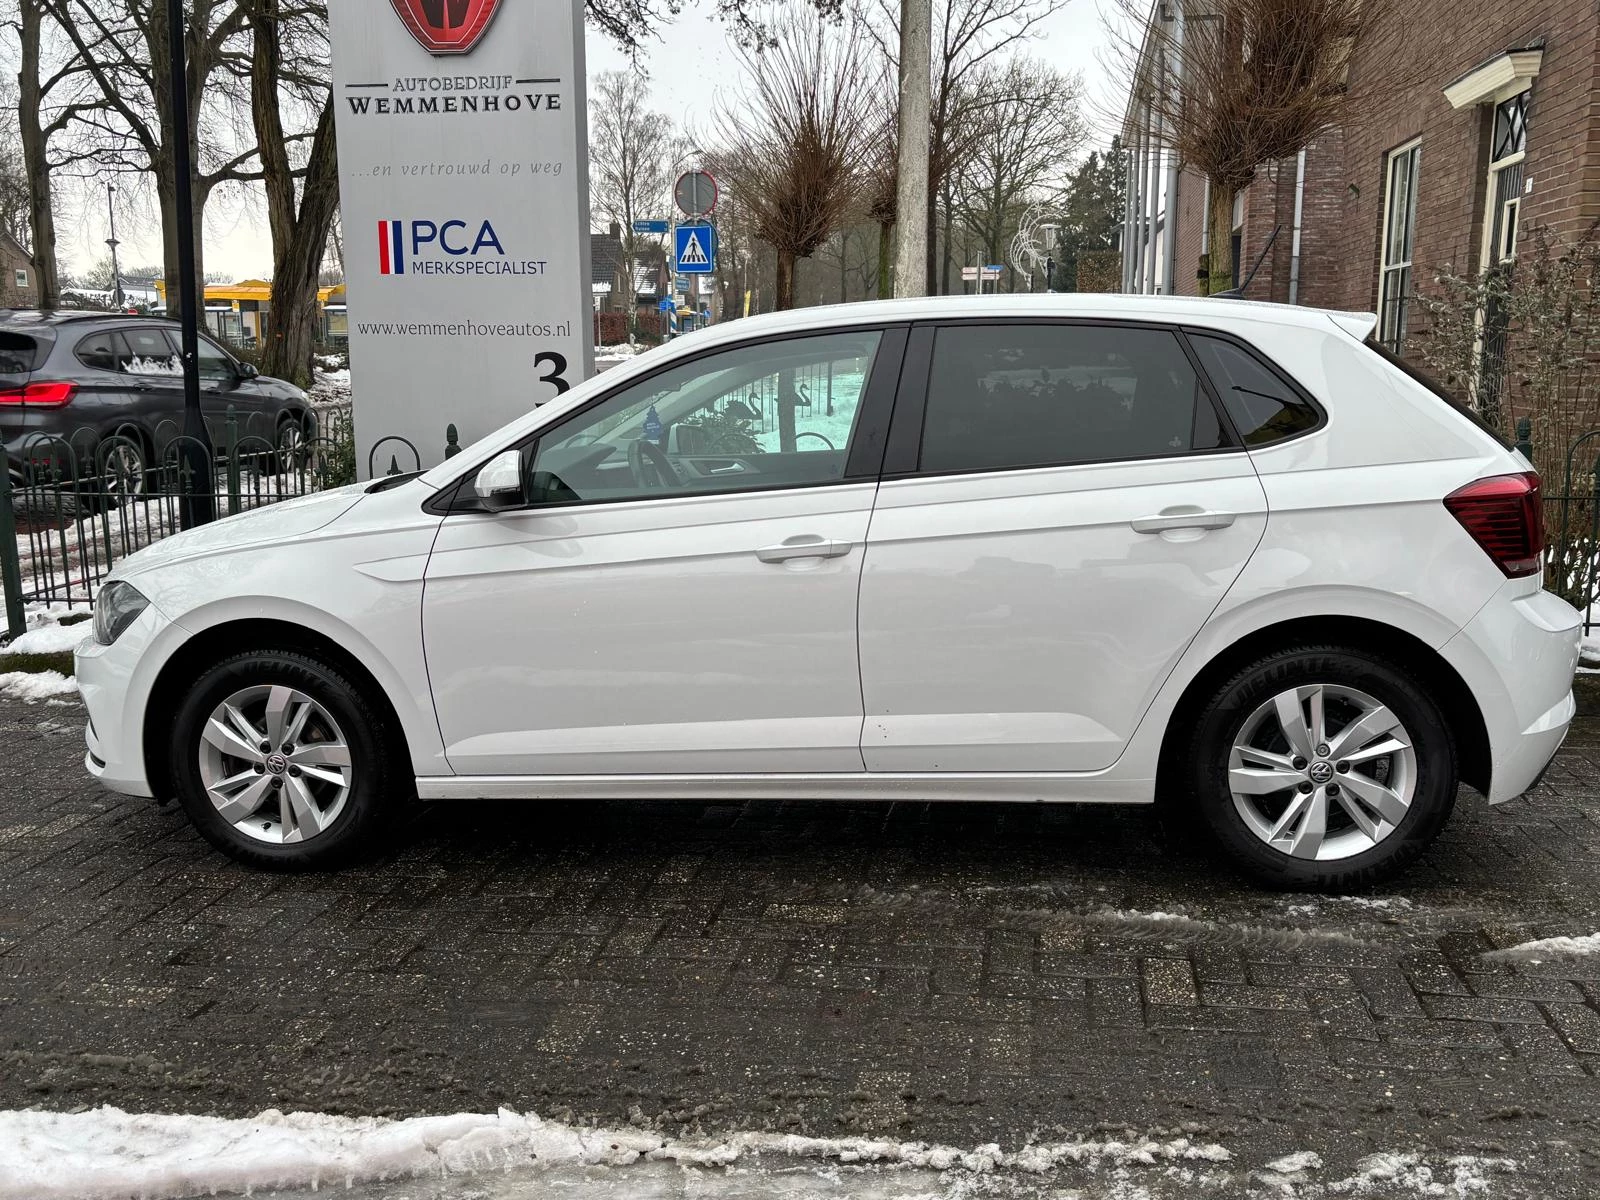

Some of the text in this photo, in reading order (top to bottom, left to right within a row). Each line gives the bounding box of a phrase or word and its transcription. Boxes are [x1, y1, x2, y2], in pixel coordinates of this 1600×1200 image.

[393, 75, 513, 92] AUTOBEDRIJF
[346, 93, 561, 115] WEMMENHOVE
[401, 159, 491, 176] vertrouwd
[500, 163, 521, 177] op
[530, 161, 563, 176] weg
[411, 220, 505, 256] PCA
[412, 261, 548, 275] MERKSPECIALIST
[357, 319, 571, 337] www.wemmenhoveautos.nl
[533, 351, 571, 409] 3
